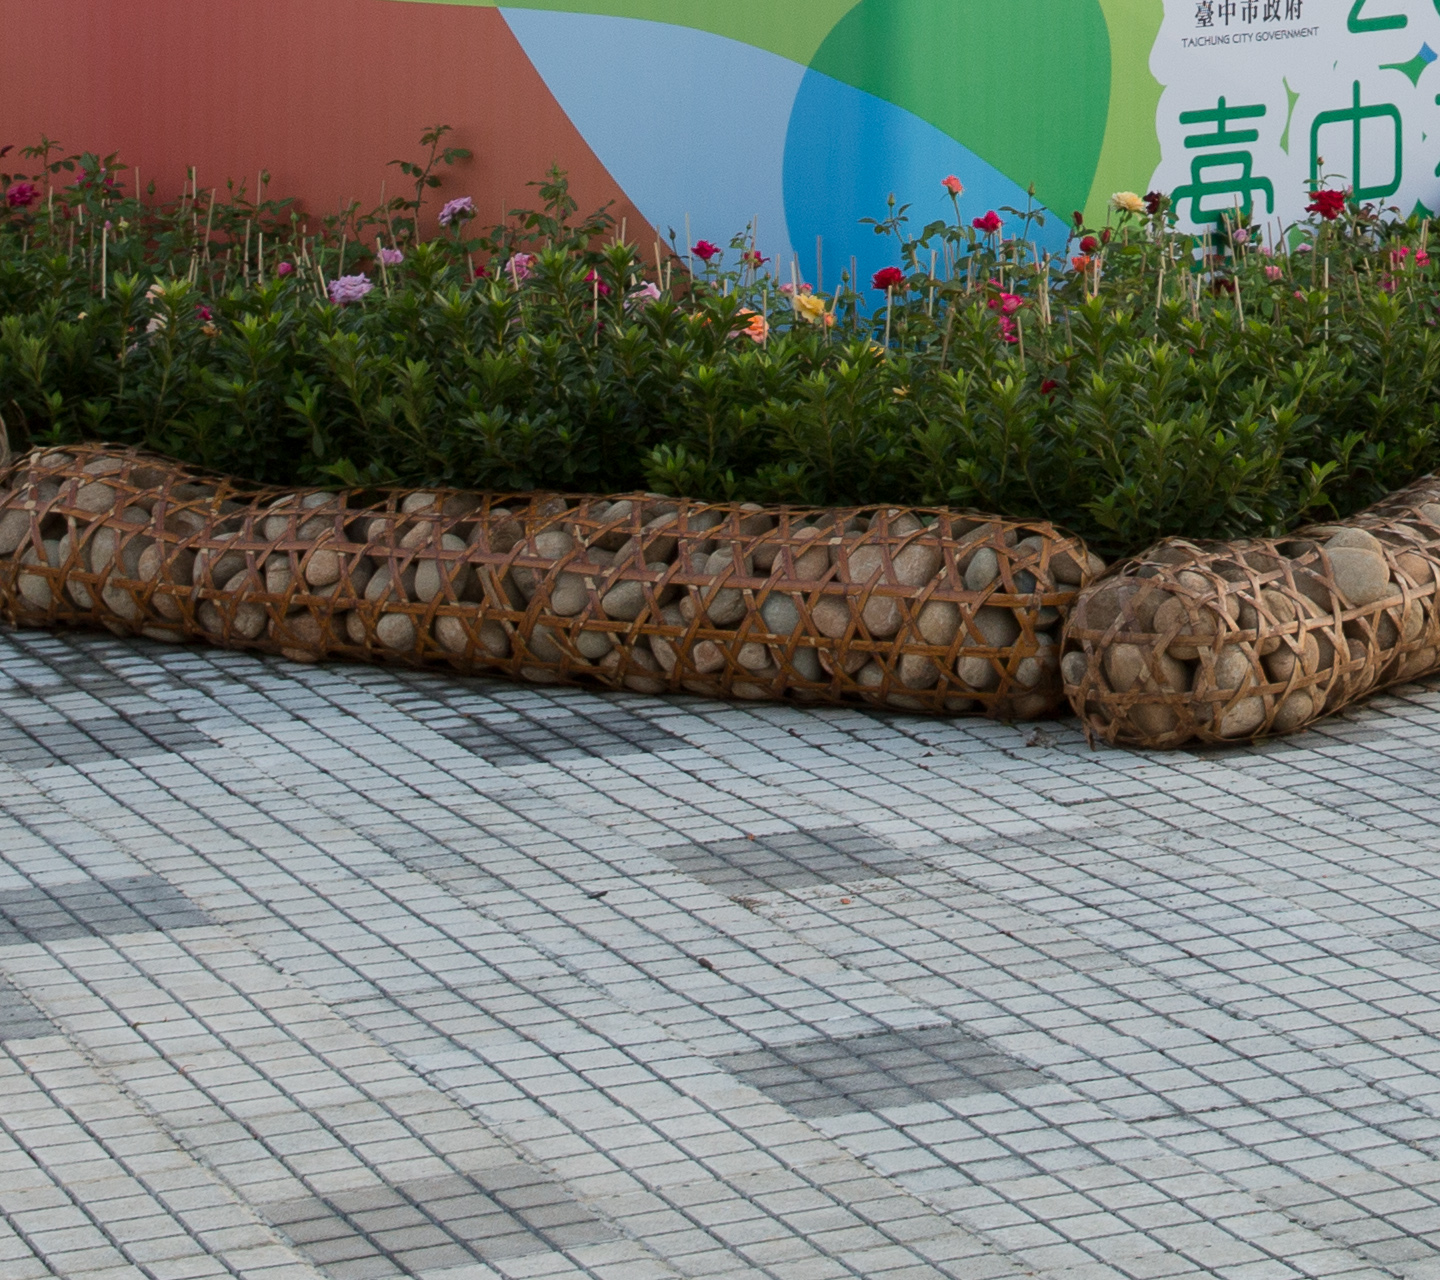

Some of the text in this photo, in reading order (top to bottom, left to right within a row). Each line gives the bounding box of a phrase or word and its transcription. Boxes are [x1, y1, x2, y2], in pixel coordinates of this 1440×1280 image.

[1182, 26, 1320, 48] TAICHUNG CITY GOVERNMENT
